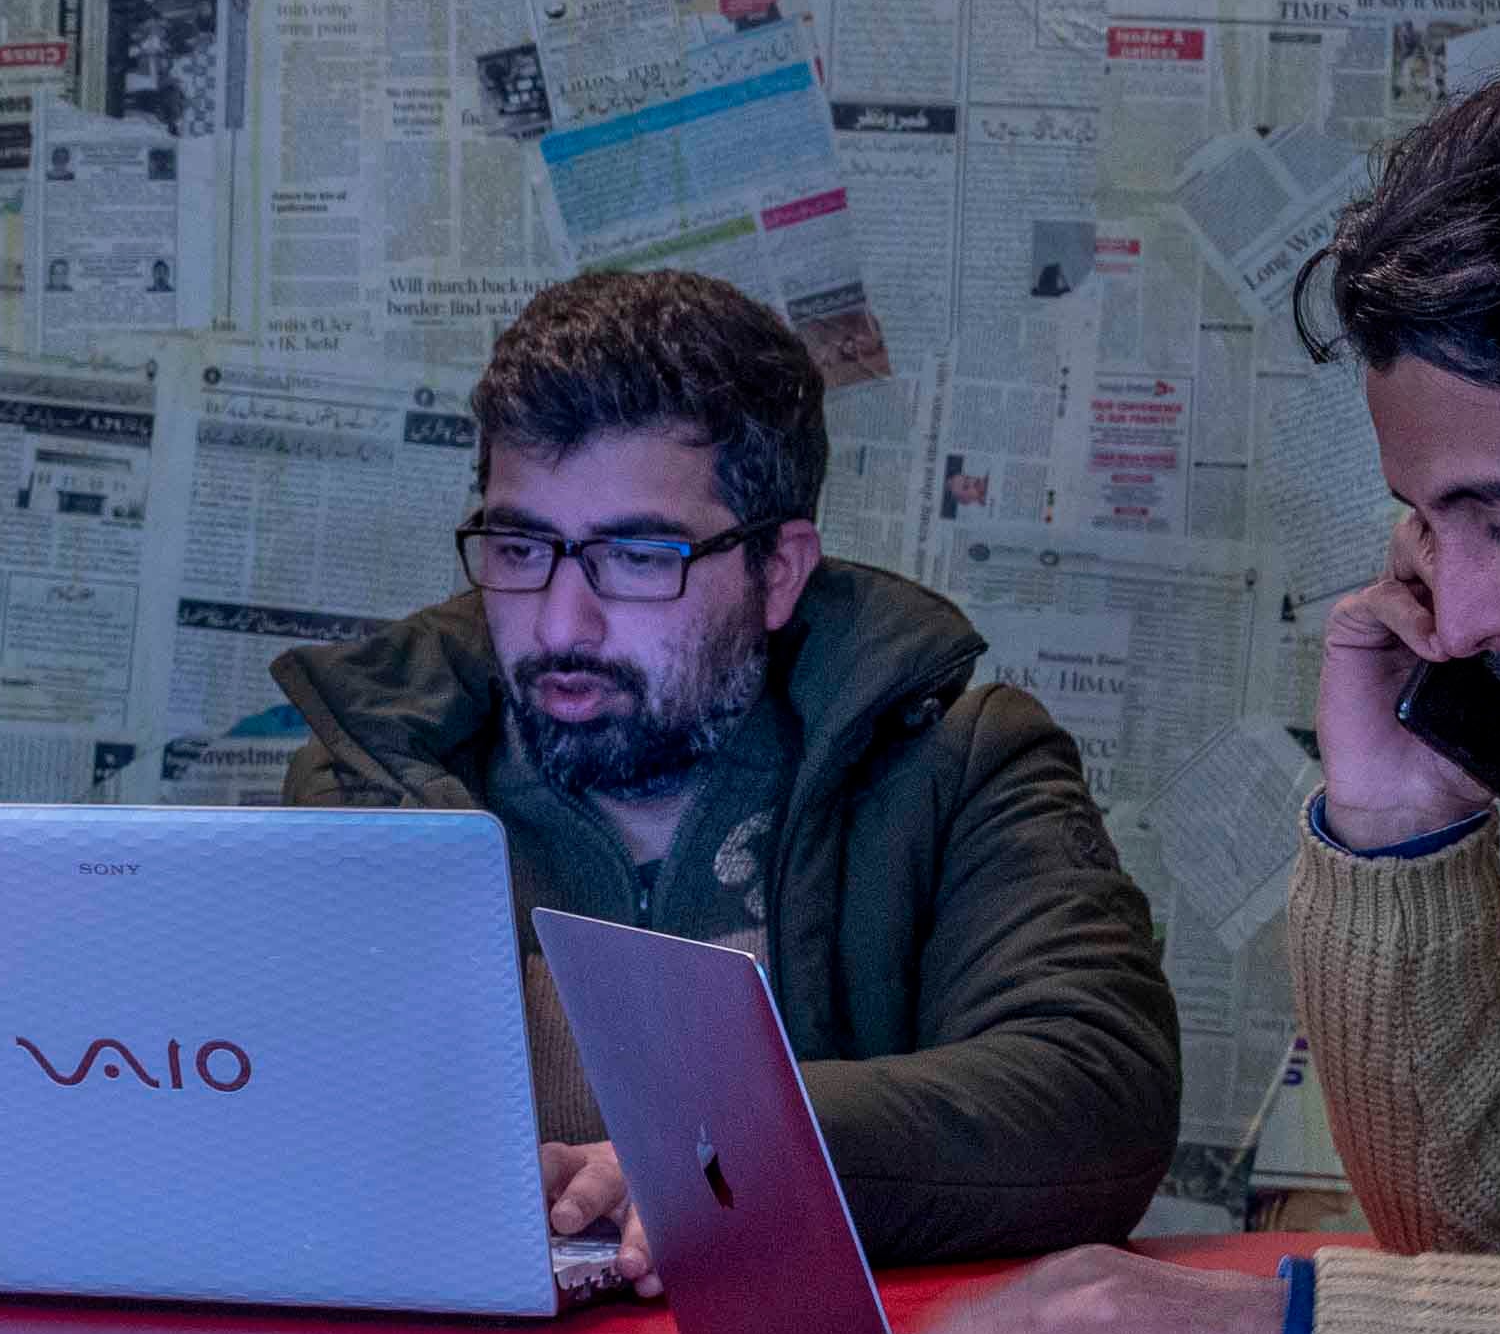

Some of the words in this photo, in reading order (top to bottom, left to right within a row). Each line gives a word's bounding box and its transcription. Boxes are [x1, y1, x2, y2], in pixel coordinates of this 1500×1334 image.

[1279, 0, 1350, 20] TIMES
[0, 45, 61, 65] Class
[1243, 247, 1292, 292] Long
[1286, 215, 1330, 256] Way
[389, 276, 424, 293] Will
[426, 277, 477, 294] march
[78, 862, 141, 876] SONY
[15, 1035, 252, 1093] VAIO
